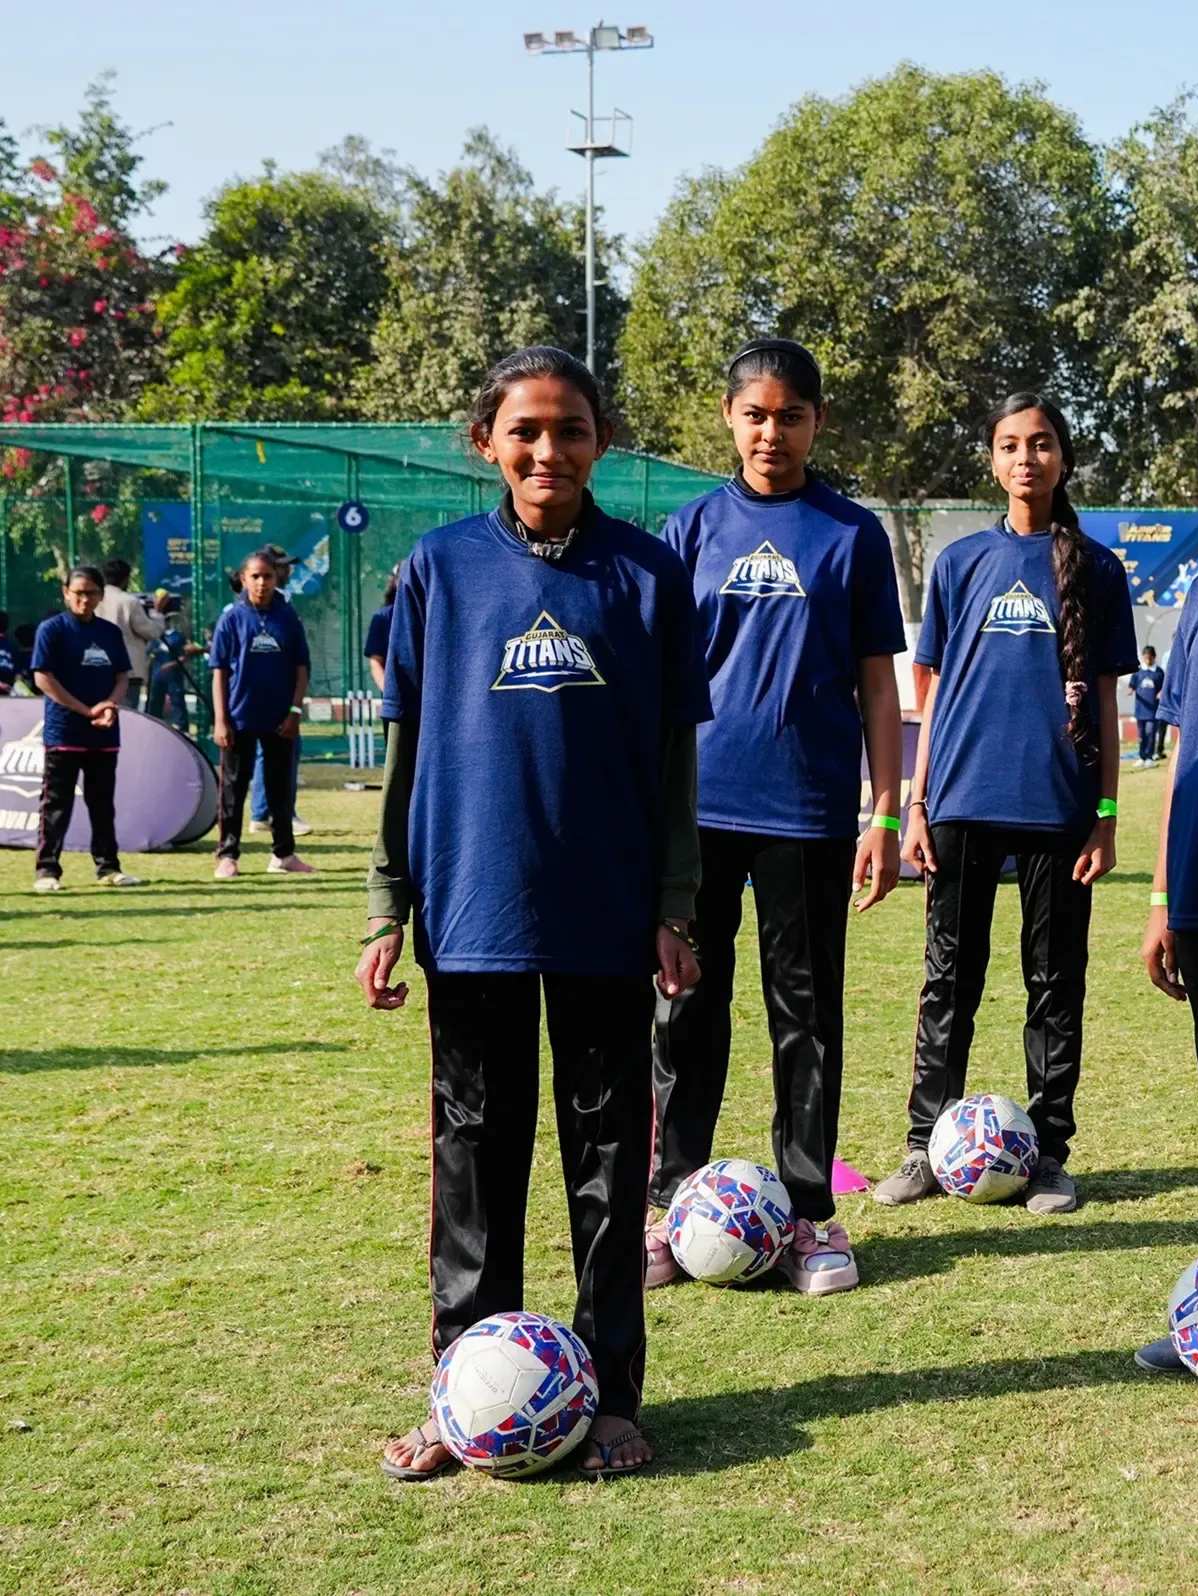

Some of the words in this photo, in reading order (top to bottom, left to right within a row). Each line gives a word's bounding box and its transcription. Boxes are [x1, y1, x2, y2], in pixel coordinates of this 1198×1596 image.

[345, 506, 363, 527] 6
[728, 556, 799, 584] TITANS
[987, 597, 1050, 622] TITANS
[525, 630, 565, 640] GUJARAT
[502, 637, 593, 673] TITANS
